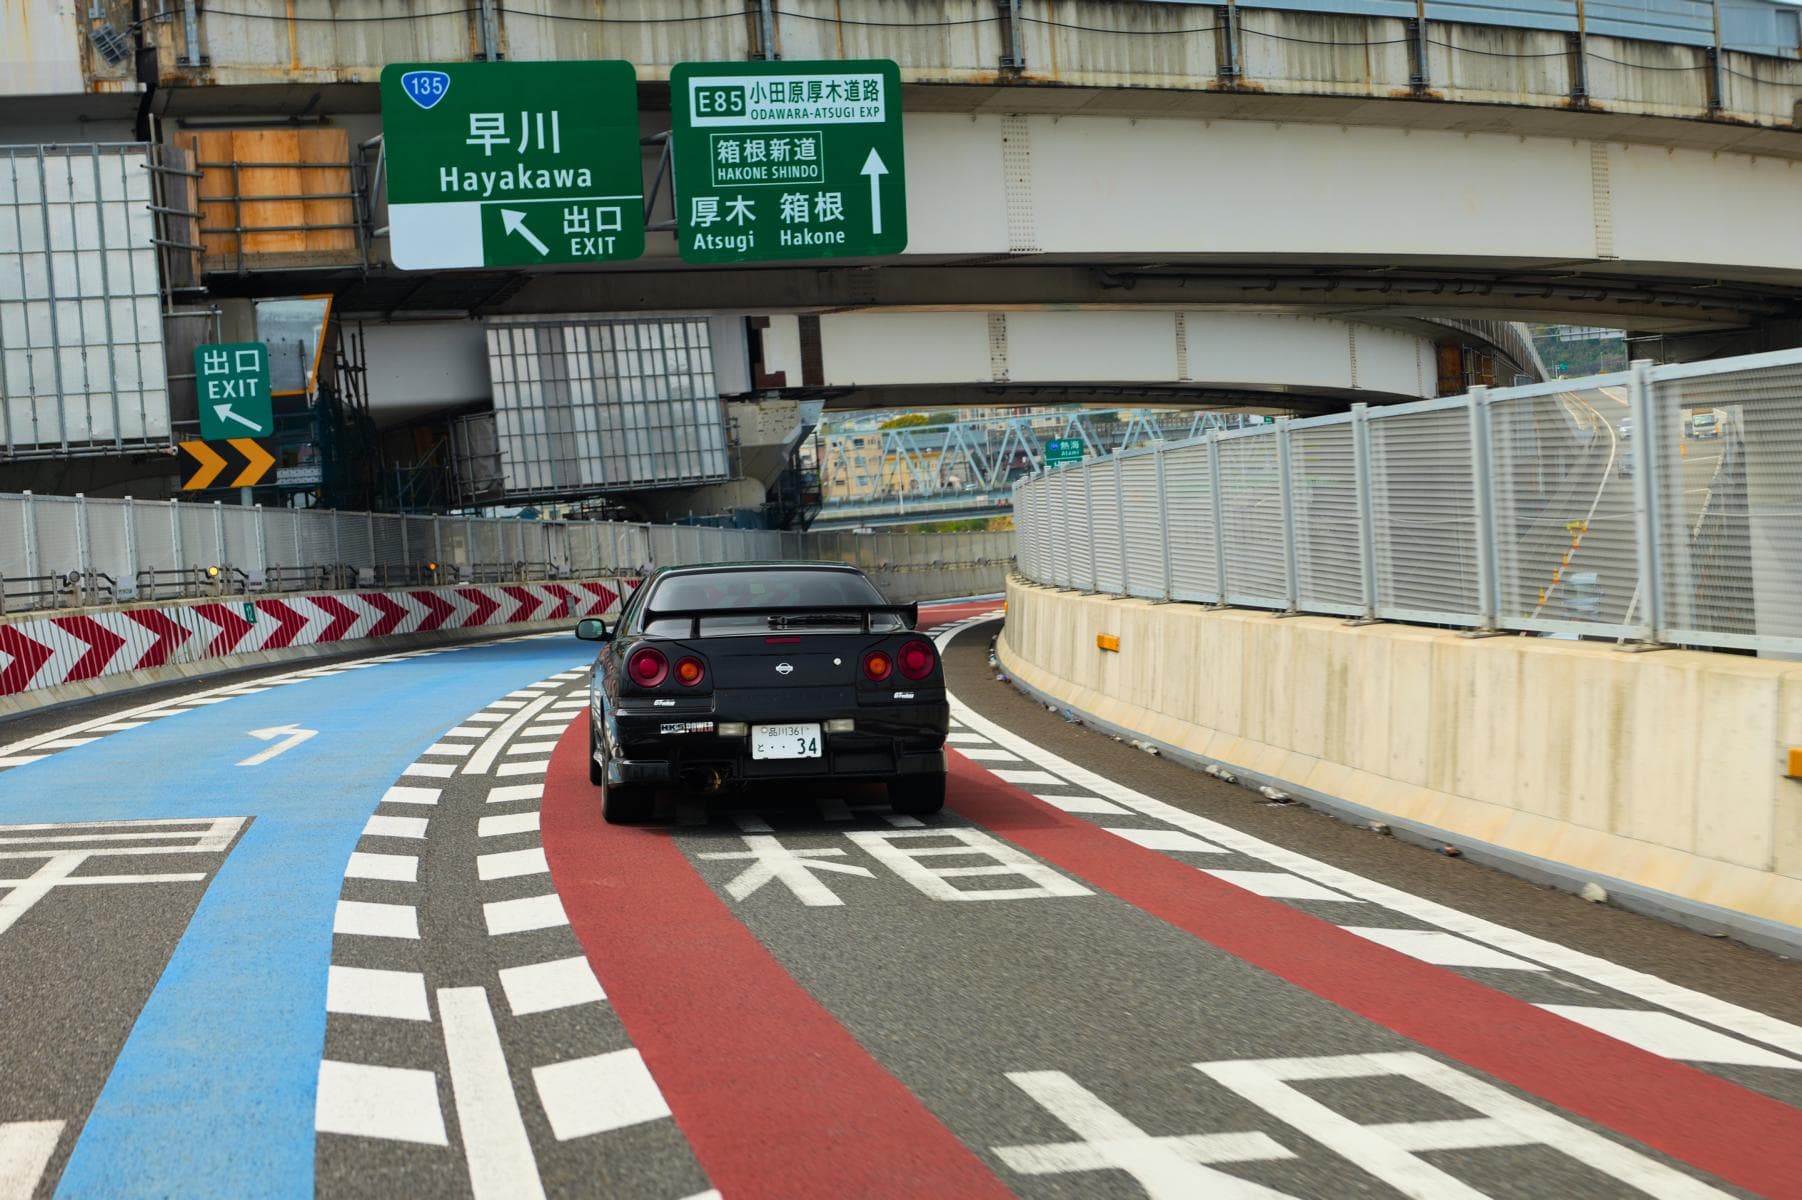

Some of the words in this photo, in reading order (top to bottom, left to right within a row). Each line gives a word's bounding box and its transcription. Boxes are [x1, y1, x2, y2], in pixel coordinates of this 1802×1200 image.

[411, 76, 443, 95] 135
[750, 78, 880, 105] 小田原厚木道路
[700, 91, 743, 112] E85
[751, 107, 855, 121] ODAWARA-ATSUGI
[860, 106, 881, 118] EXP
[466, 110, 561, 157] 早川
[717, 137, 818, 164] 箱根新道
[440, 163, 593, 198] Hayakawa
[718, 167, 768, 181] HAKONE
[772, 164, 819, 179] SHINDO
[563, 205, 622, 234] 出口
[690, 194, 757, 228] 厚木
[780, 191, 845, 225] 箱根
[571, 236, 617, 256] EXIT
[693, 230, 755, 253] Atsugi
[780, 228, 846, 247] Hakone
[203, 349, 261, 376] 出口
[208, 378, 259, 400] EXIT
